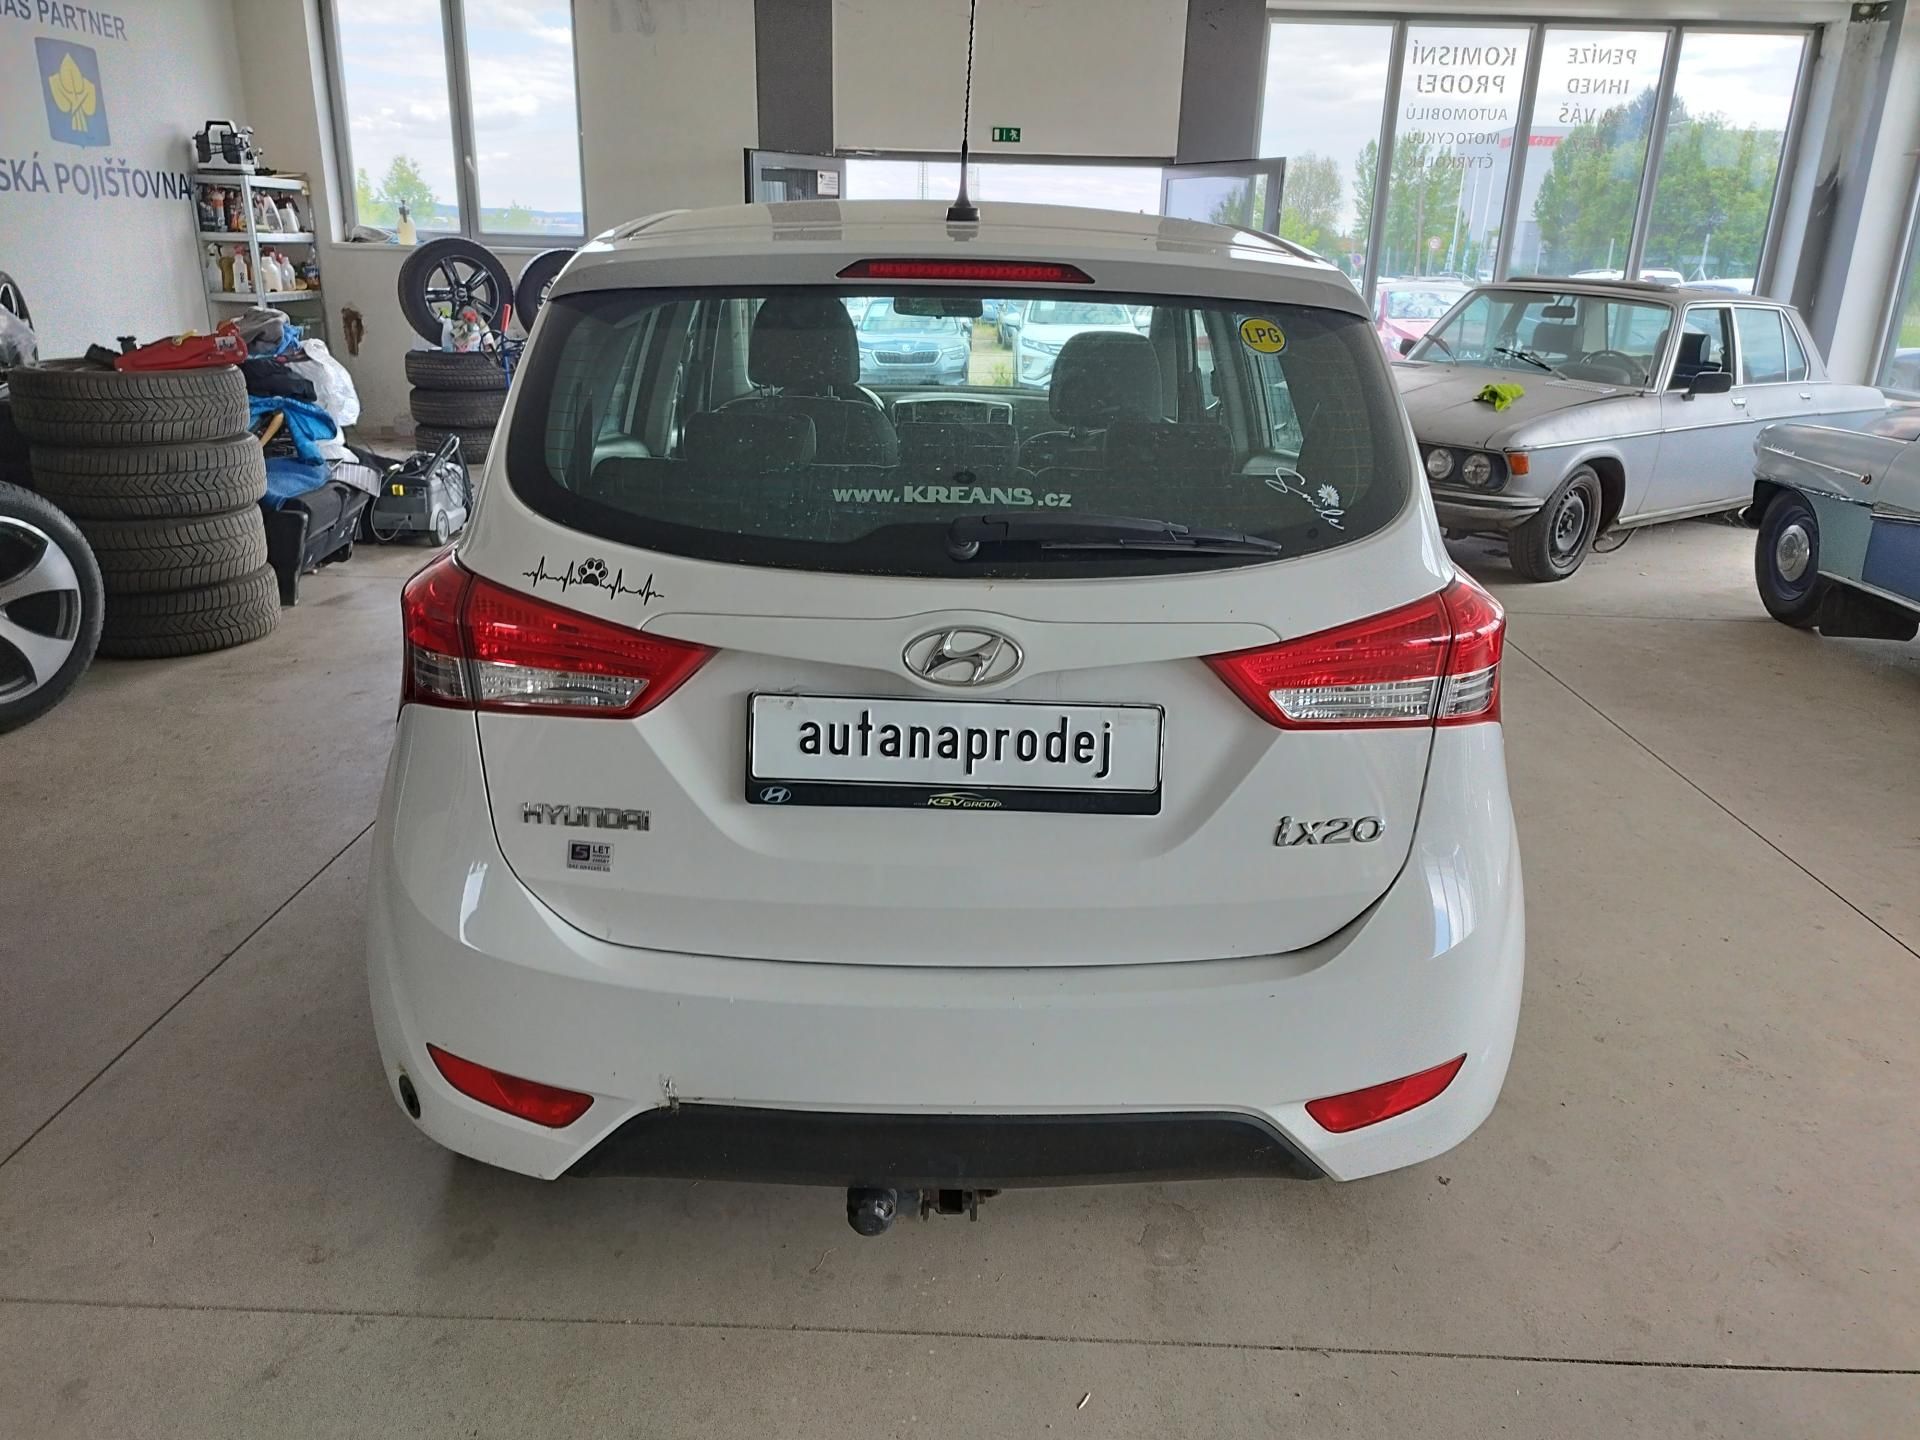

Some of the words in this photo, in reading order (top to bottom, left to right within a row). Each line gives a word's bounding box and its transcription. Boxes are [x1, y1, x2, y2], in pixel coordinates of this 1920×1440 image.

[37, 0, 128, 41] PARTNER
[54, 157, 194, 201] POJIŠŤOVNA
[1245, 327, 1281, 344] LPG
[832, 485, 1072, 507] www.KREANS.cz
[799, 709, 1113, 778] autanaprodej
[522, 802, 650, 831] HYUNDAI
[1272, 815, 1385, 847] ix20
[592, 845, 611, 855] LET
